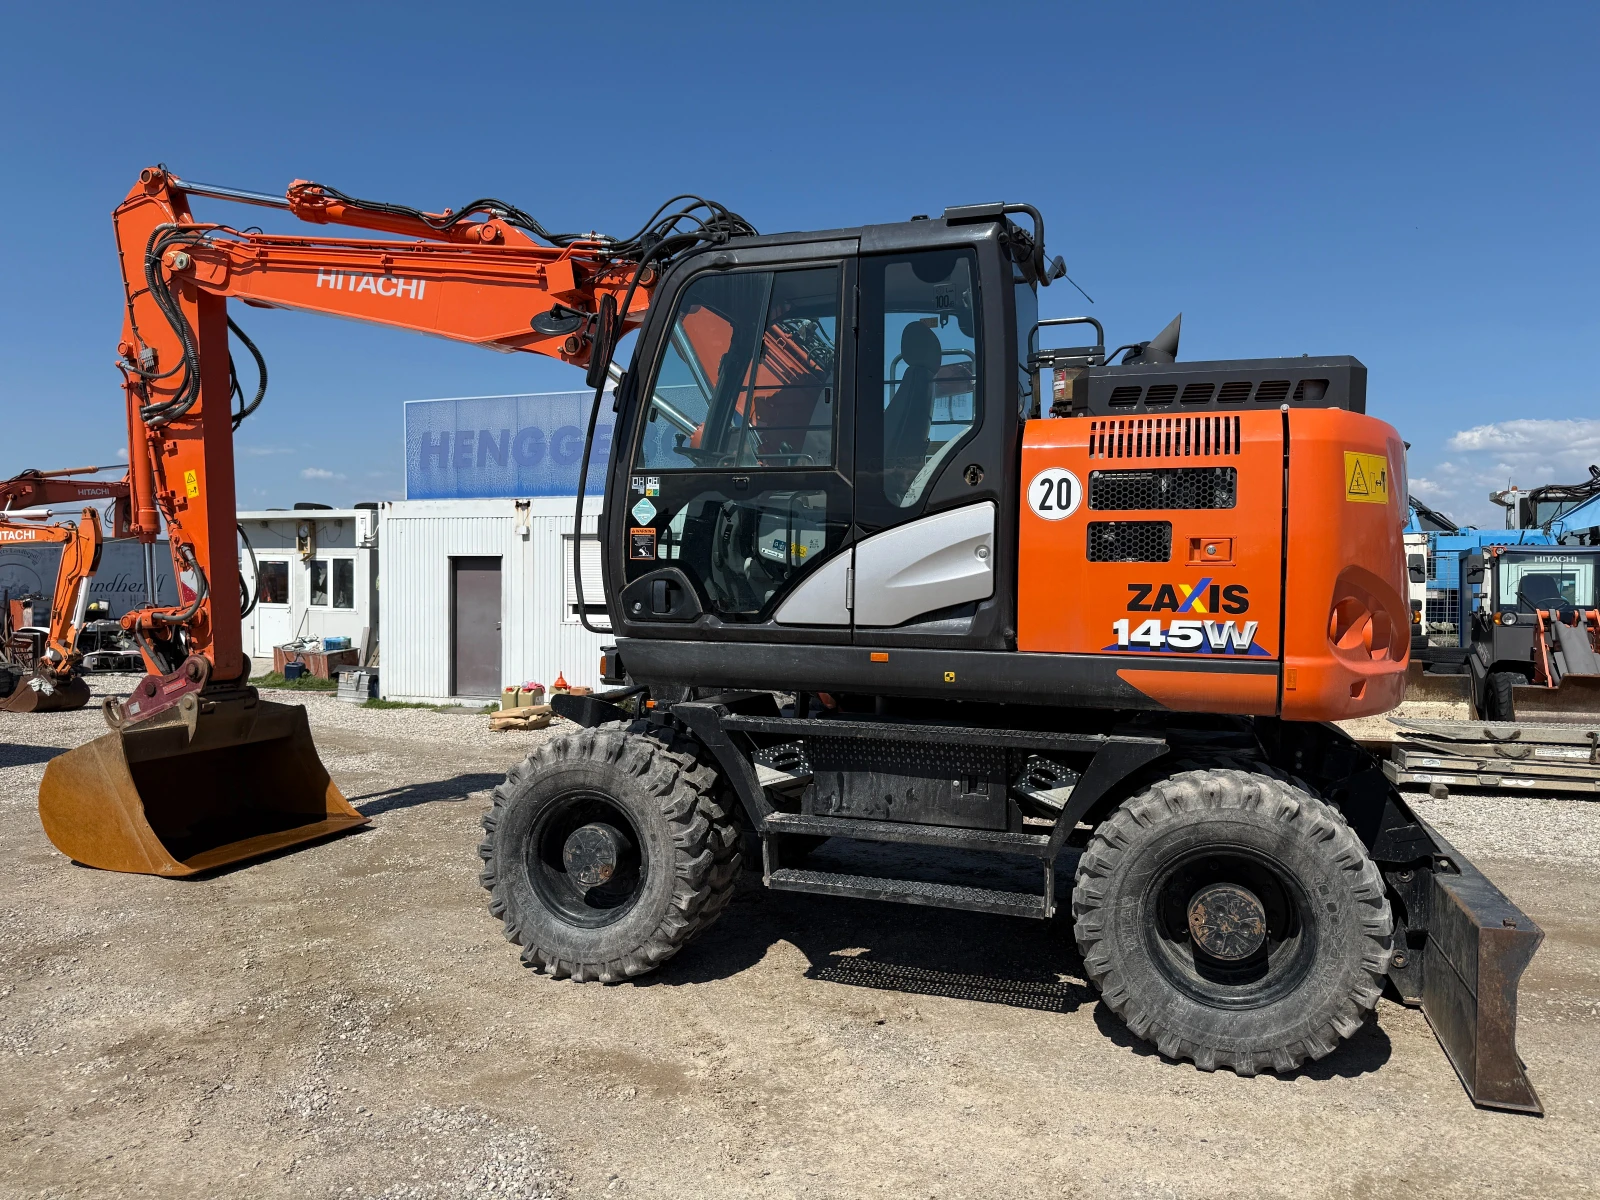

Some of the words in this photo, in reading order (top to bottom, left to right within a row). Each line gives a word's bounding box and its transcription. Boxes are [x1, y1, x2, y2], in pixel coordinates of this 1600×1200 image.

[316, 268, 426, 300] HITACHI
[936, 295, 949, 308] 100
[78, 488, 110, 496] HITACHI
[1038, 477, 1072, 511] 20
[0, 530, 36, 541] ITACHI
[1534, 555, 1578, 563] HITACHI
[1126, 577, 1250, 615] ZAXIS
[1112, 618, 1259, 653] 145W
